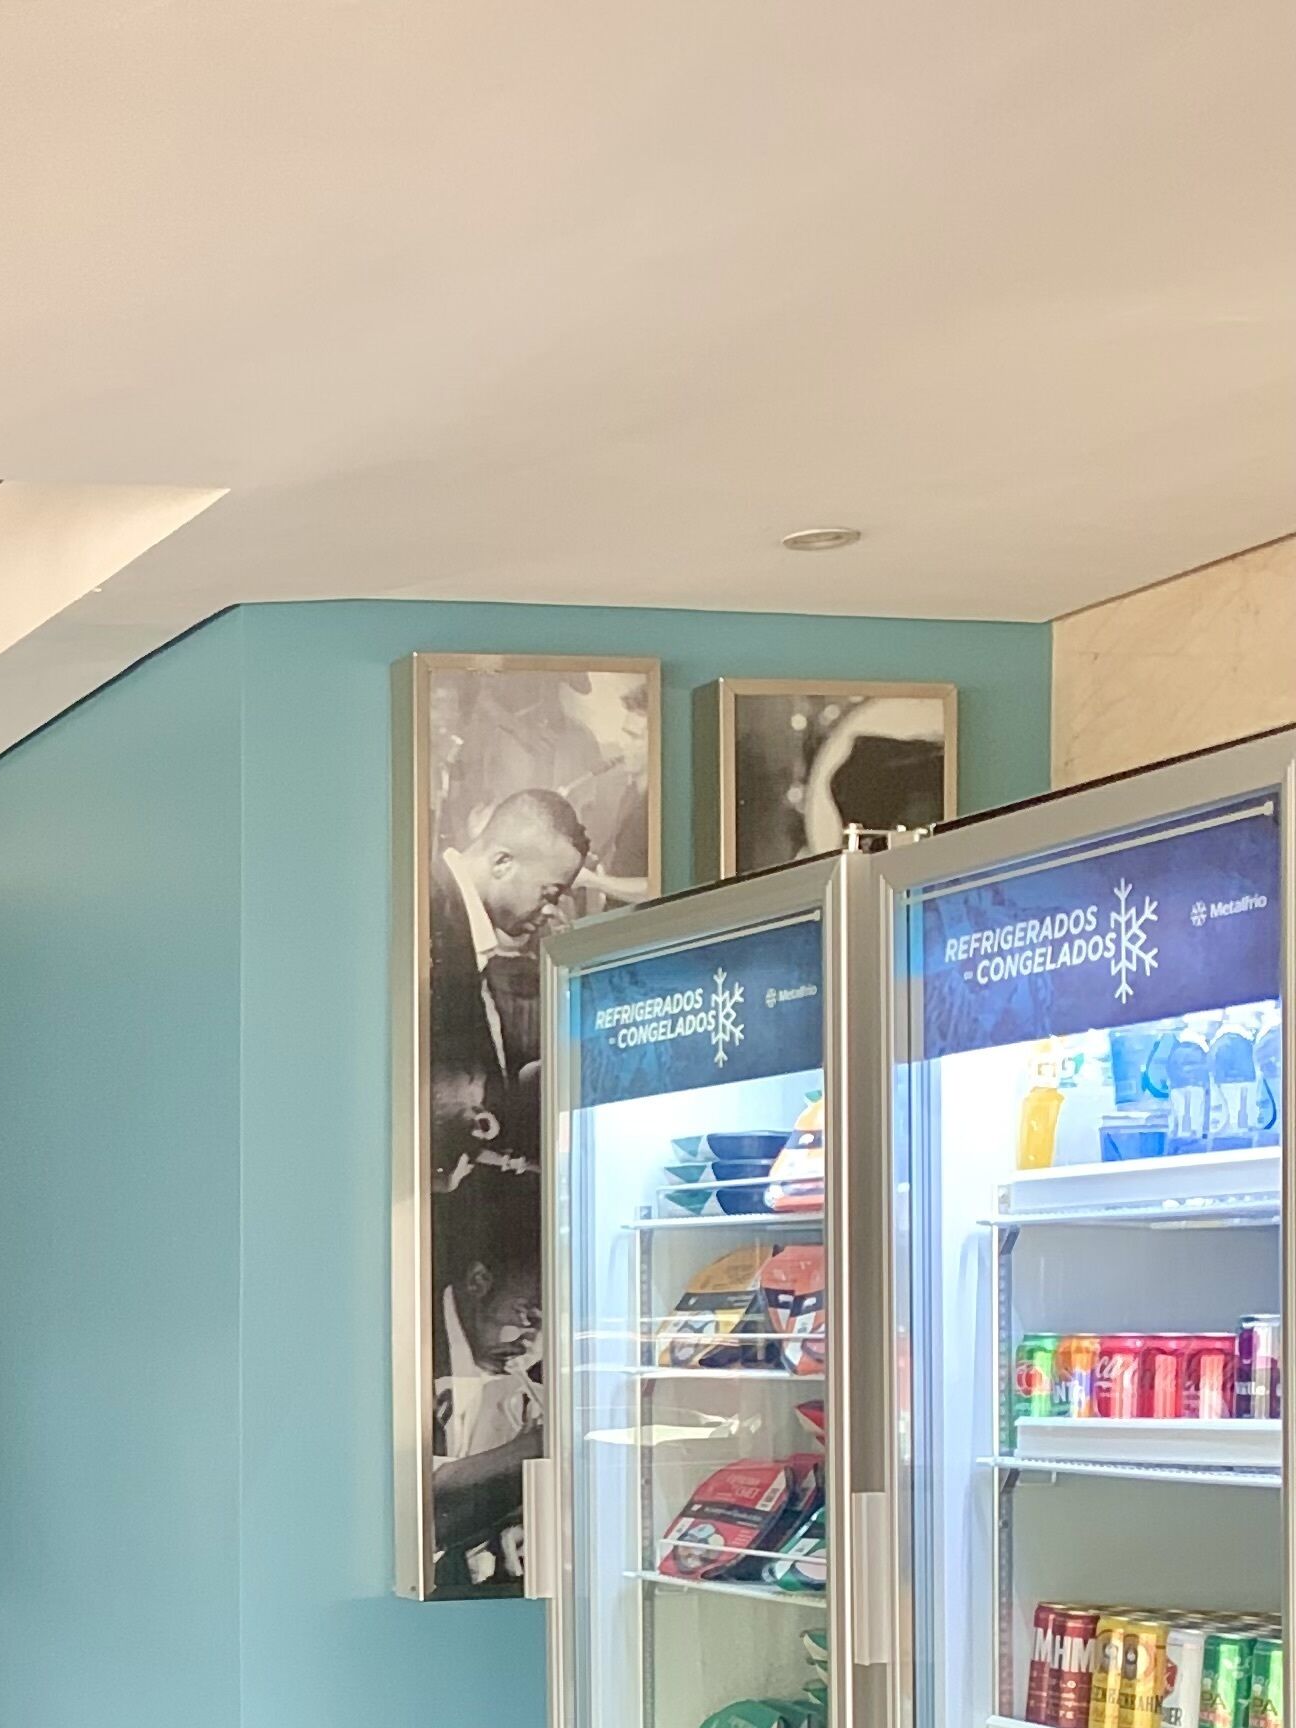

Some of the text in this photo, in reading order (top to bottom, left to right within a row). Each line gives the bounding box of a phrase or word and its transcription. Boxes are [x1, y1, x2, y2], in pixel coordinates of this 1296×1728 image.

[944, 905, 1098, 963] REFRIGERADOS
[976, 932, 1117, 985] CONGELADOS
[595, 987, 703, 1030] REFRIGERADOS
[617, 1009, 716, 1049] CONGELADOS
